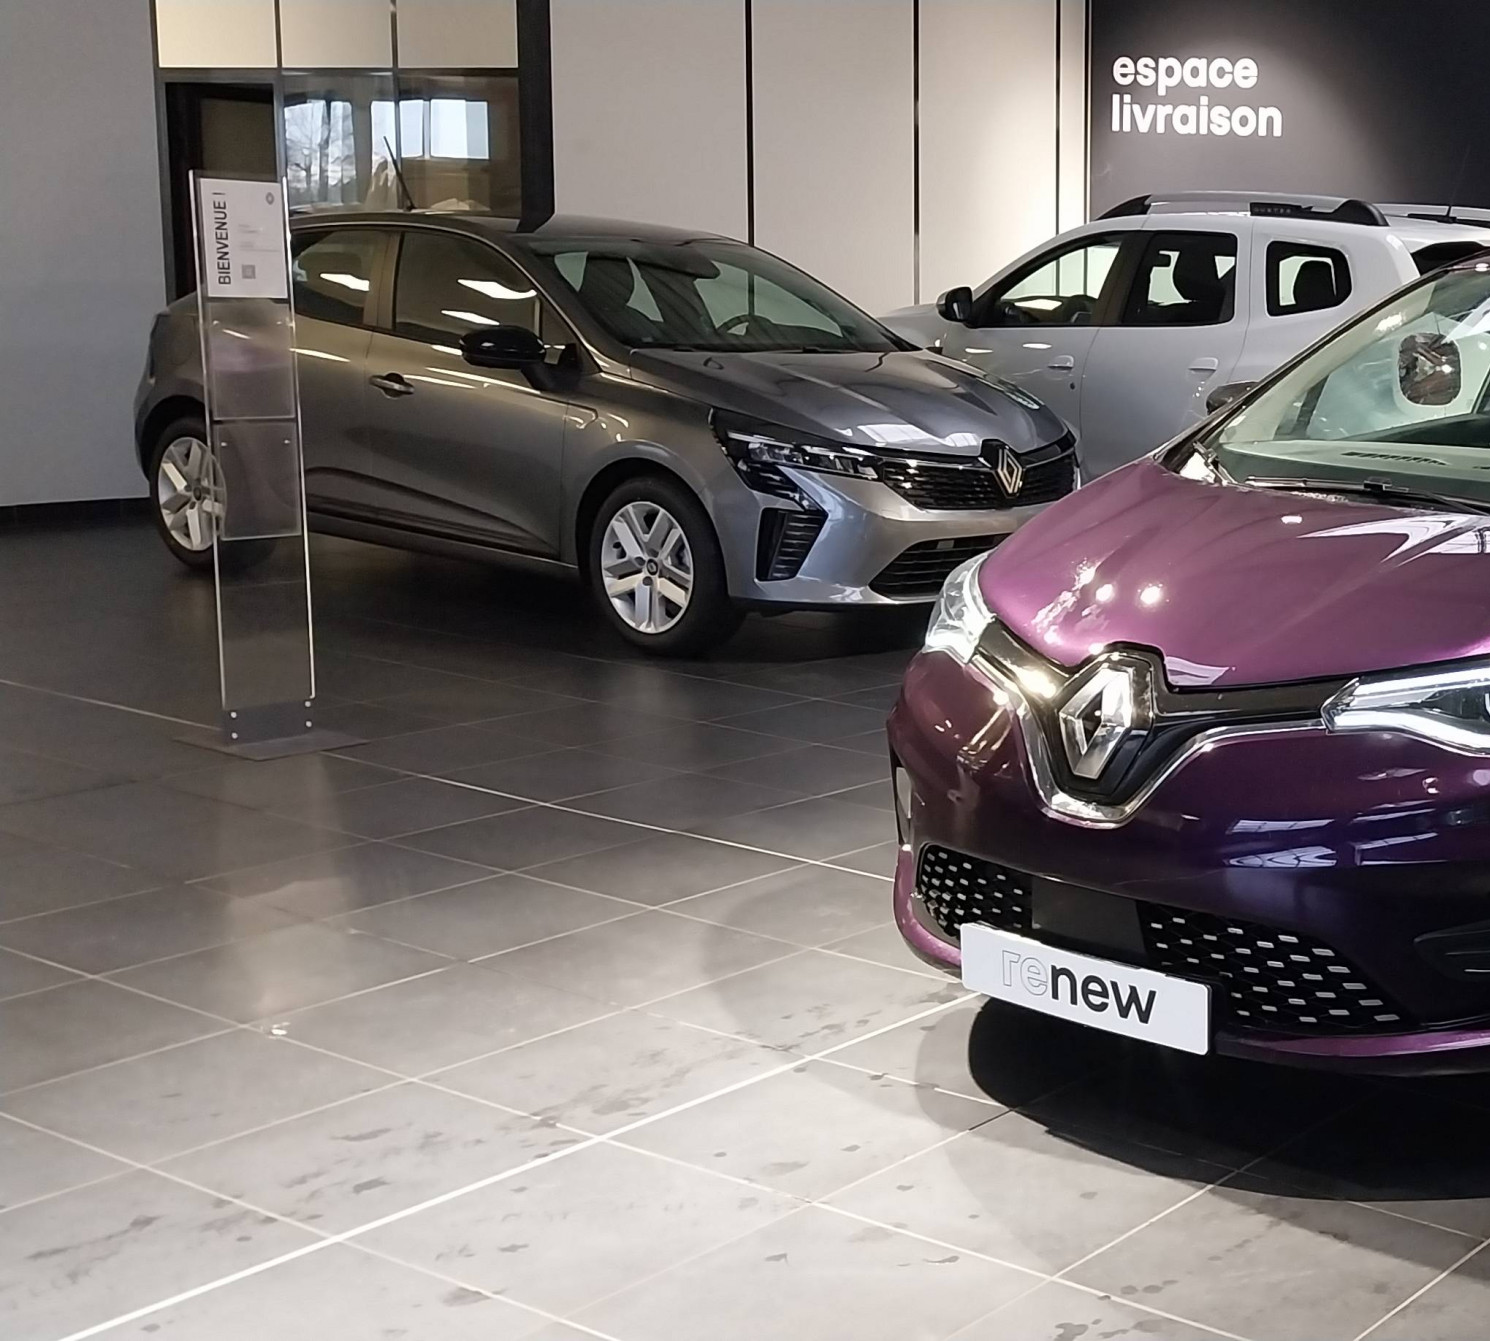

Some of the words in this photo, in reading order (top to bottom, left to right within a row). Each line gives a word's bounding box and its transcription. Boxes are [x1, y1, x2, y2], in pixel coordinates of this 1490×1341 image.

[1112, 56, 1259, 97] espace
[1111, 93, 1283, 137] livraison
[212, 200, 231, 285] BIENVENUE
[1001, 949, 1157, 1025] renew
